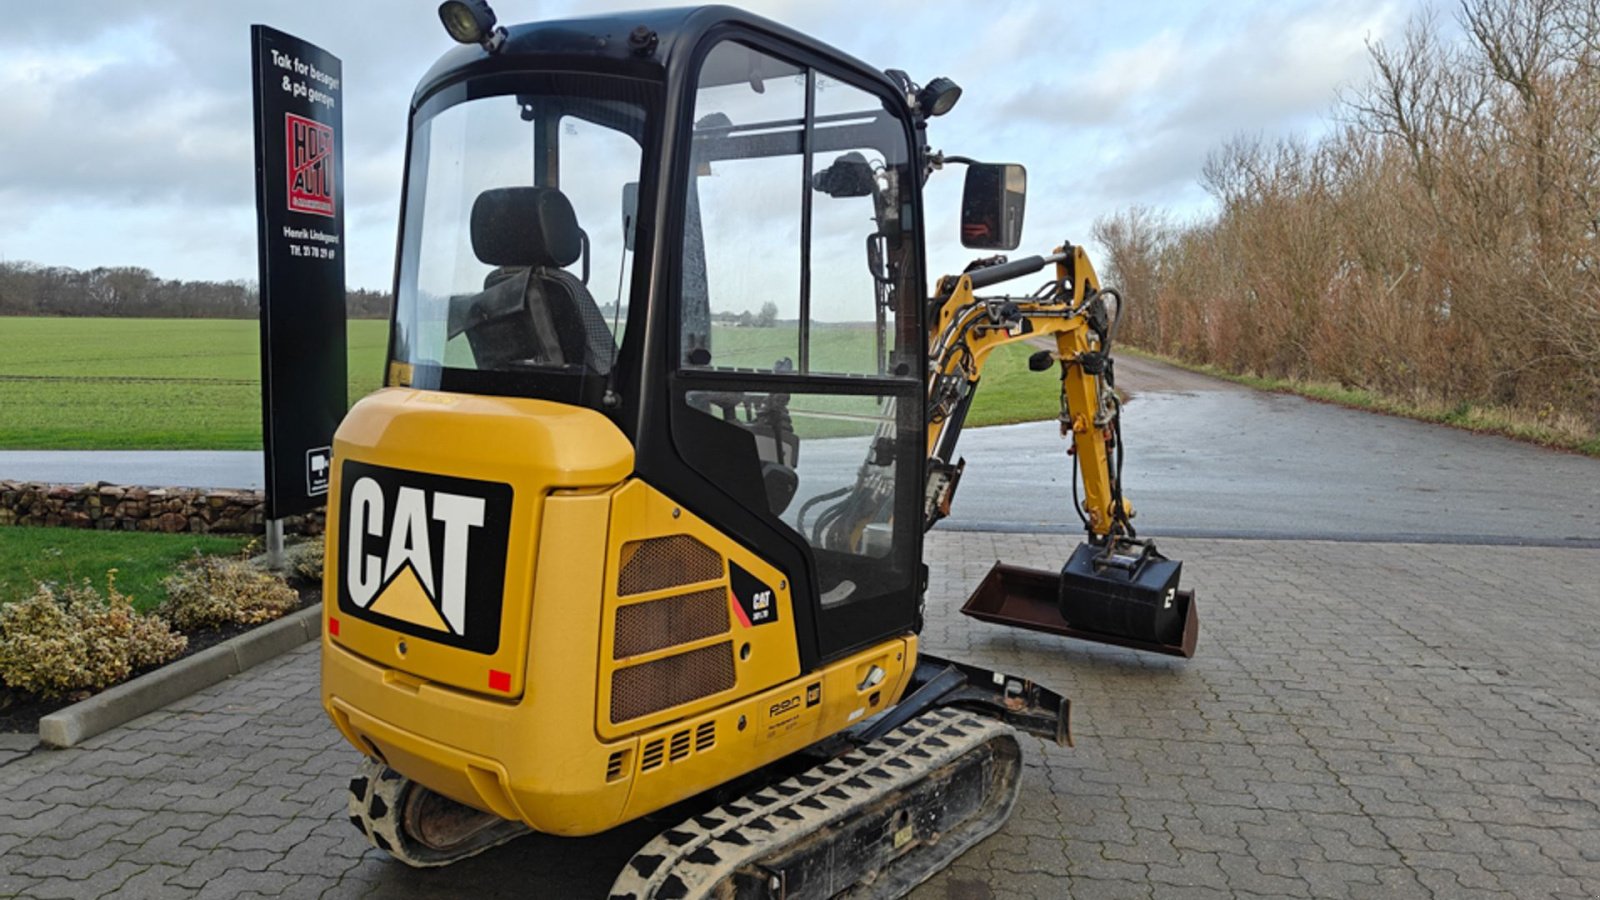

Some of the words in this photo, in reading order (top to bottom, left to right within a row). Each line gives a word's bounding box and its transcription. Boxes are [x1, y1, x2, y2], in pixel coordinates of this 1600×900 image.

[271, 49, 292, 70] Tak
[294, 57, 309, 76] for
[281, 75, 292, 92] &
[293, 81, 307, 98] på
[308, 88, 335, 110] gensyn
[283, 226, 309, 239] Henrik
[347, 476, 487, 637] CAT
[752, 590, 771, 611] CAT
